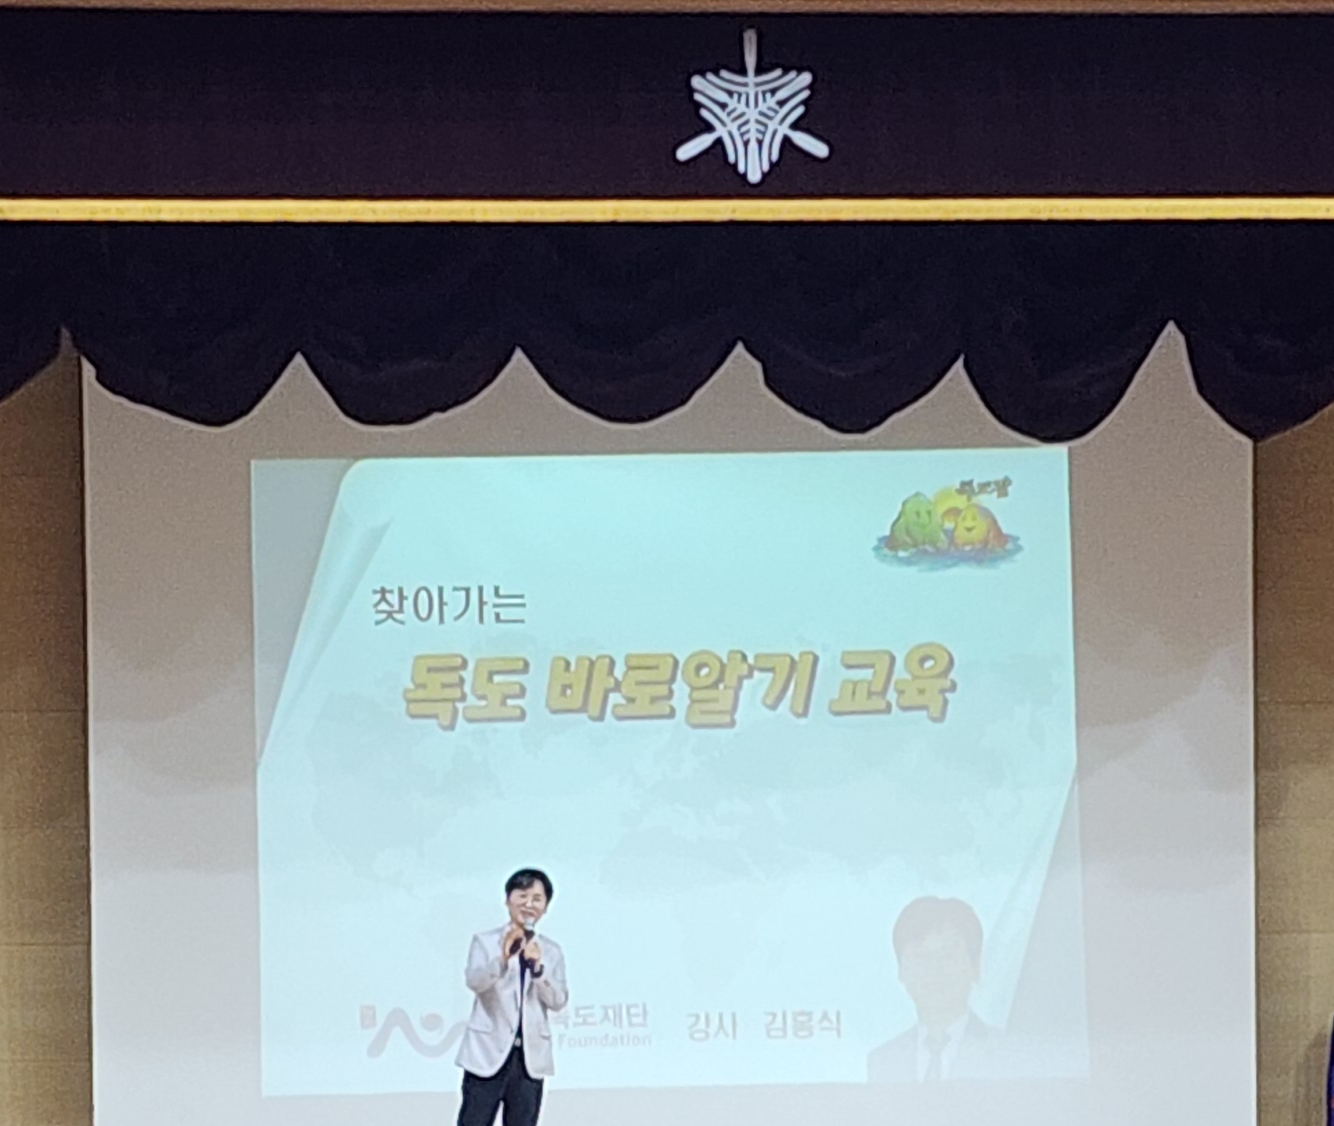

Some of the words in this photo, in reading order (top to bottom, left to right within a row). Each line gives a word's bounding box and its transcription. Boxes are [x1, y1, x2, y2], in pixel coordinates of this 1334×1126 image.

[371, 585, 527, 627] 찾아가는
[403, 653, 529, 731] 독도
[545, 649, 819, 729] 바로알기
[828, 642, 957, 723] 교육
[557, 1032, 652, 1050] Foundation
